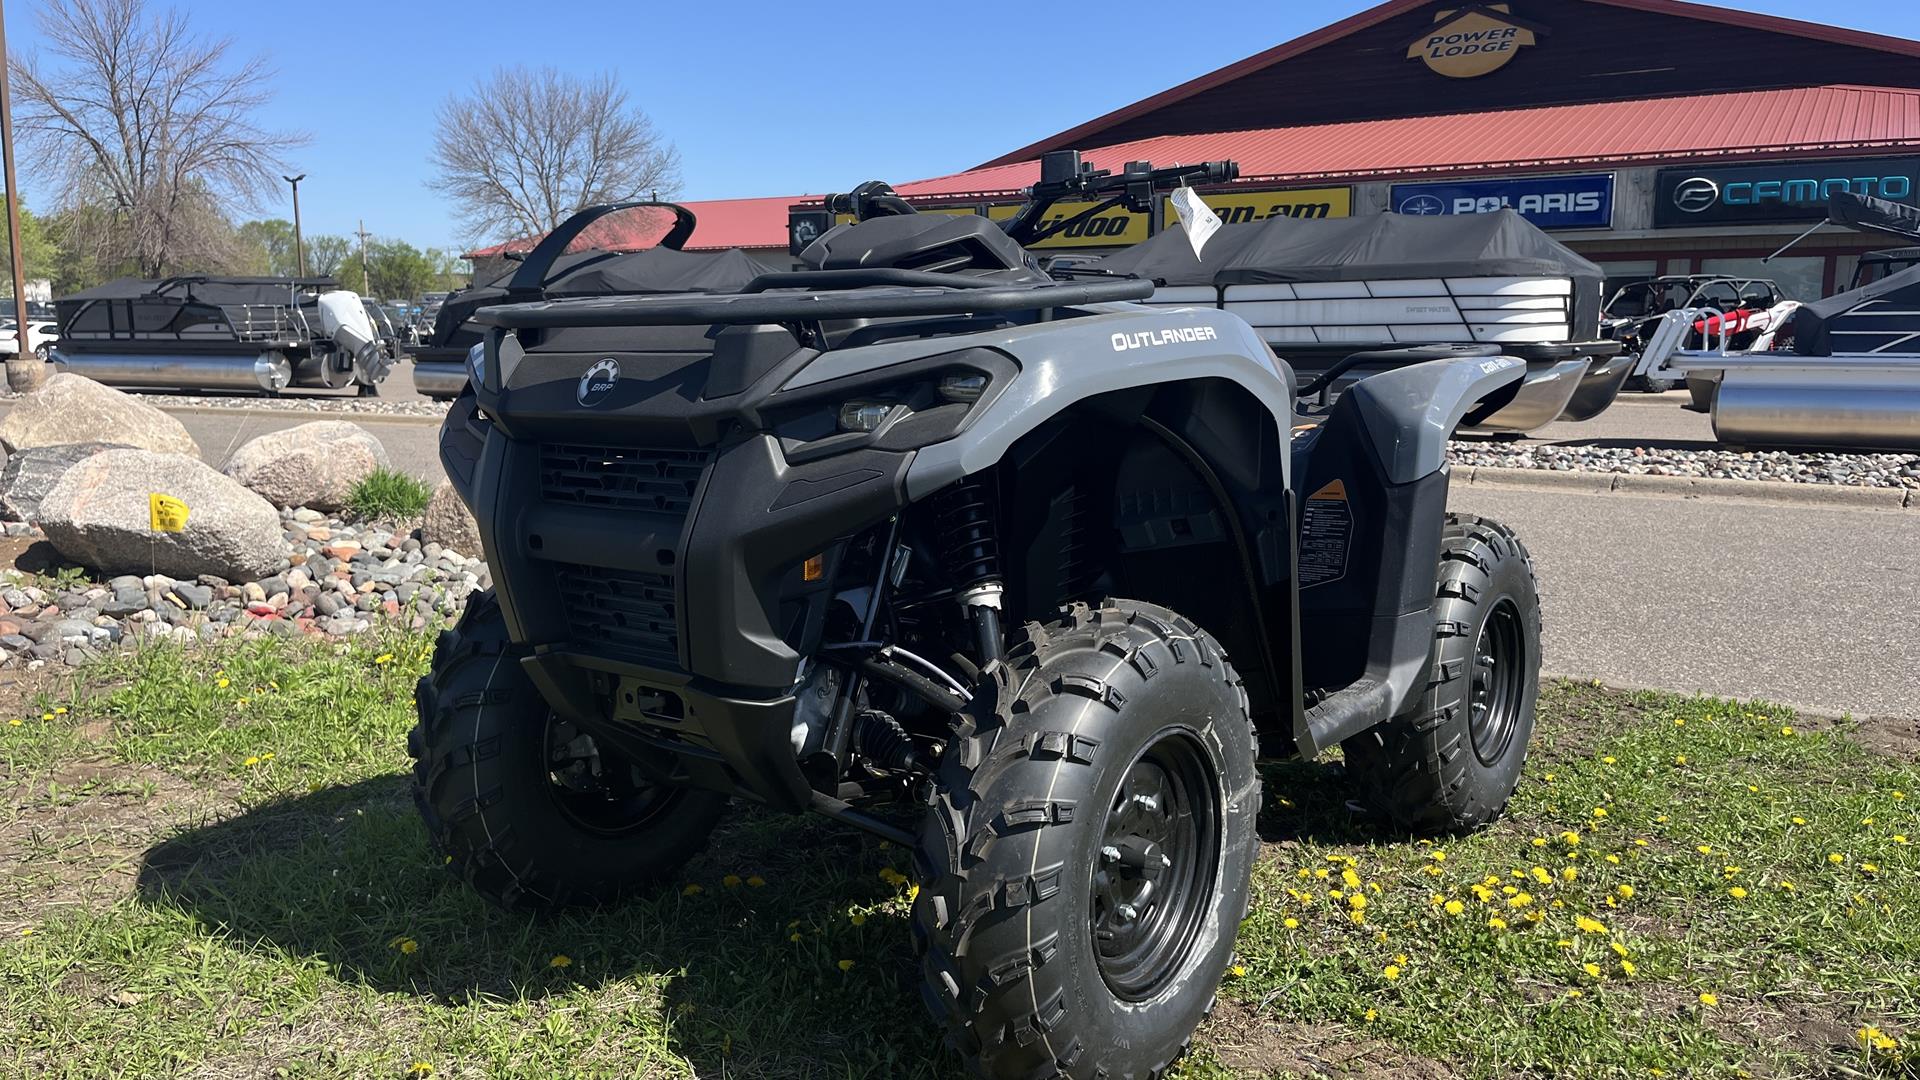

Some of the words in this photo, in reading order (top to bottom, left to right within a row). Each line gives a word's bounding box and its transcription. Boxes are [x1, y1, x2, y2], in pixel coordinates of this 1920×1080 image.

[1426, 27, 1518, 49] POWER
[1430, 40, 1513, 59] LODGE
[1723, 176, 1909, 205] CFMOTO
[1111, 326, 1218, 352] OUTLANDER
[591, 383, 614, 391] BRP
